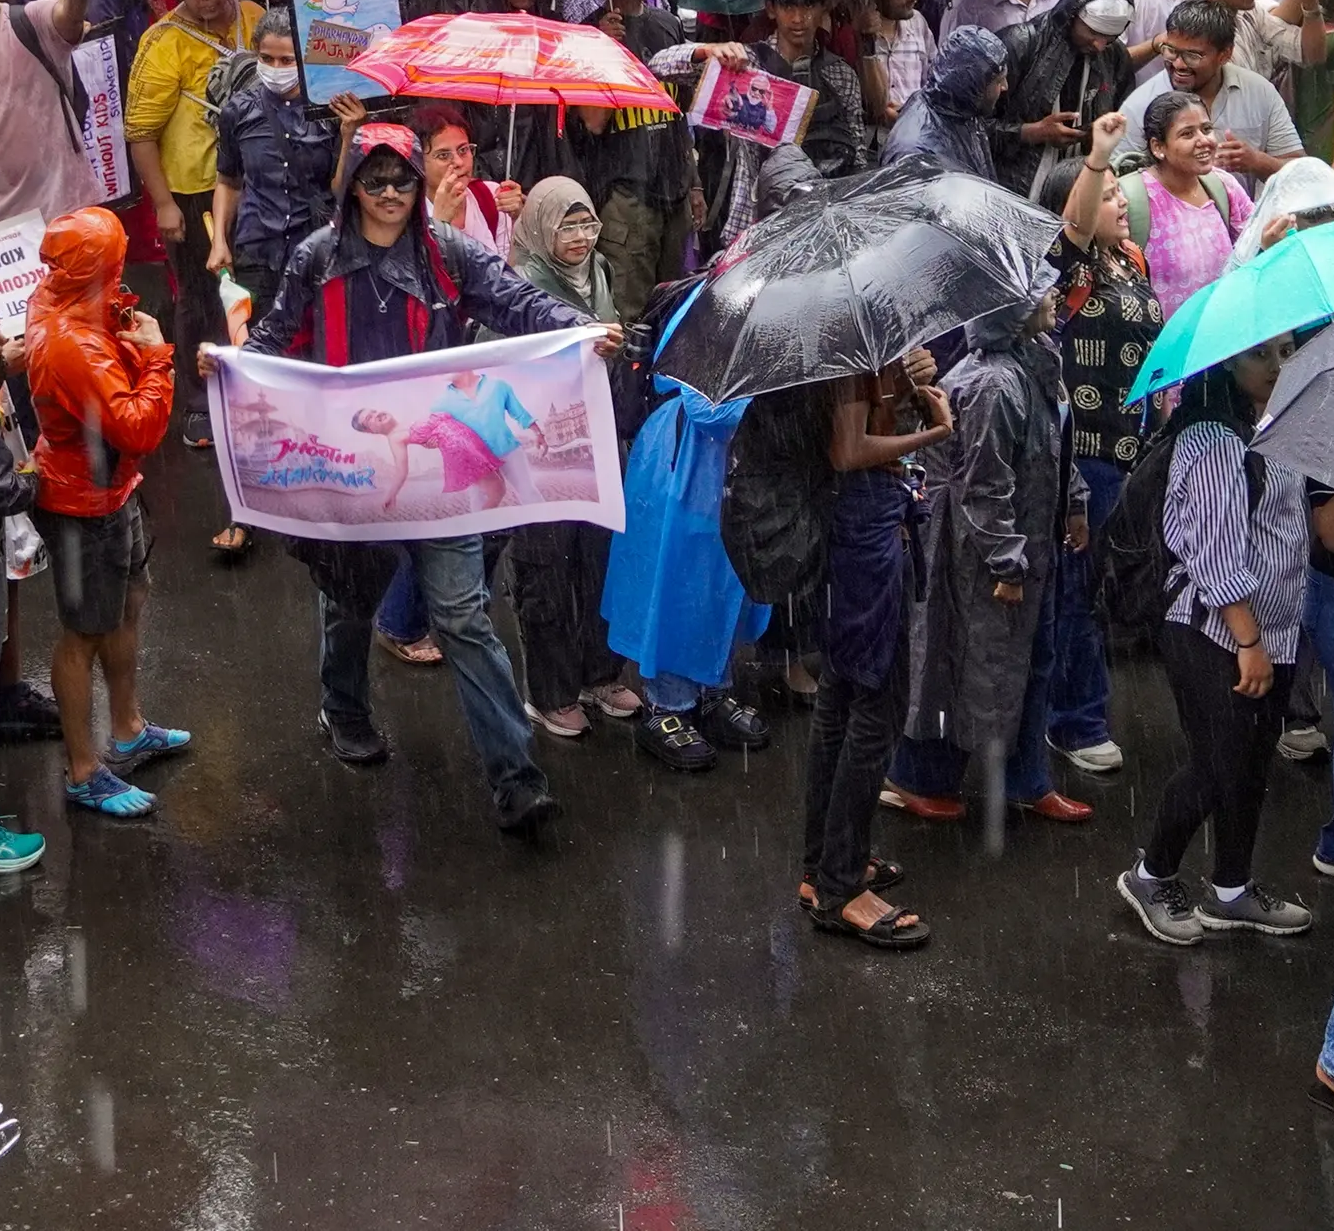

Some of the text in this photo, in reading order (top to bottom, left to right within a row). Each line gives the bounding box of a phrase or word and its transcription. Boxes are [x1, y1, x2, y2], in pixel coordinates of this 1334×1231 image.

[312, 38, 327, 52] JA
[327, 43, 345, 59] JA
[105, 64, 121, 119] SHOWED
[93, 92, 119, 198] WITHOUT KIDS
